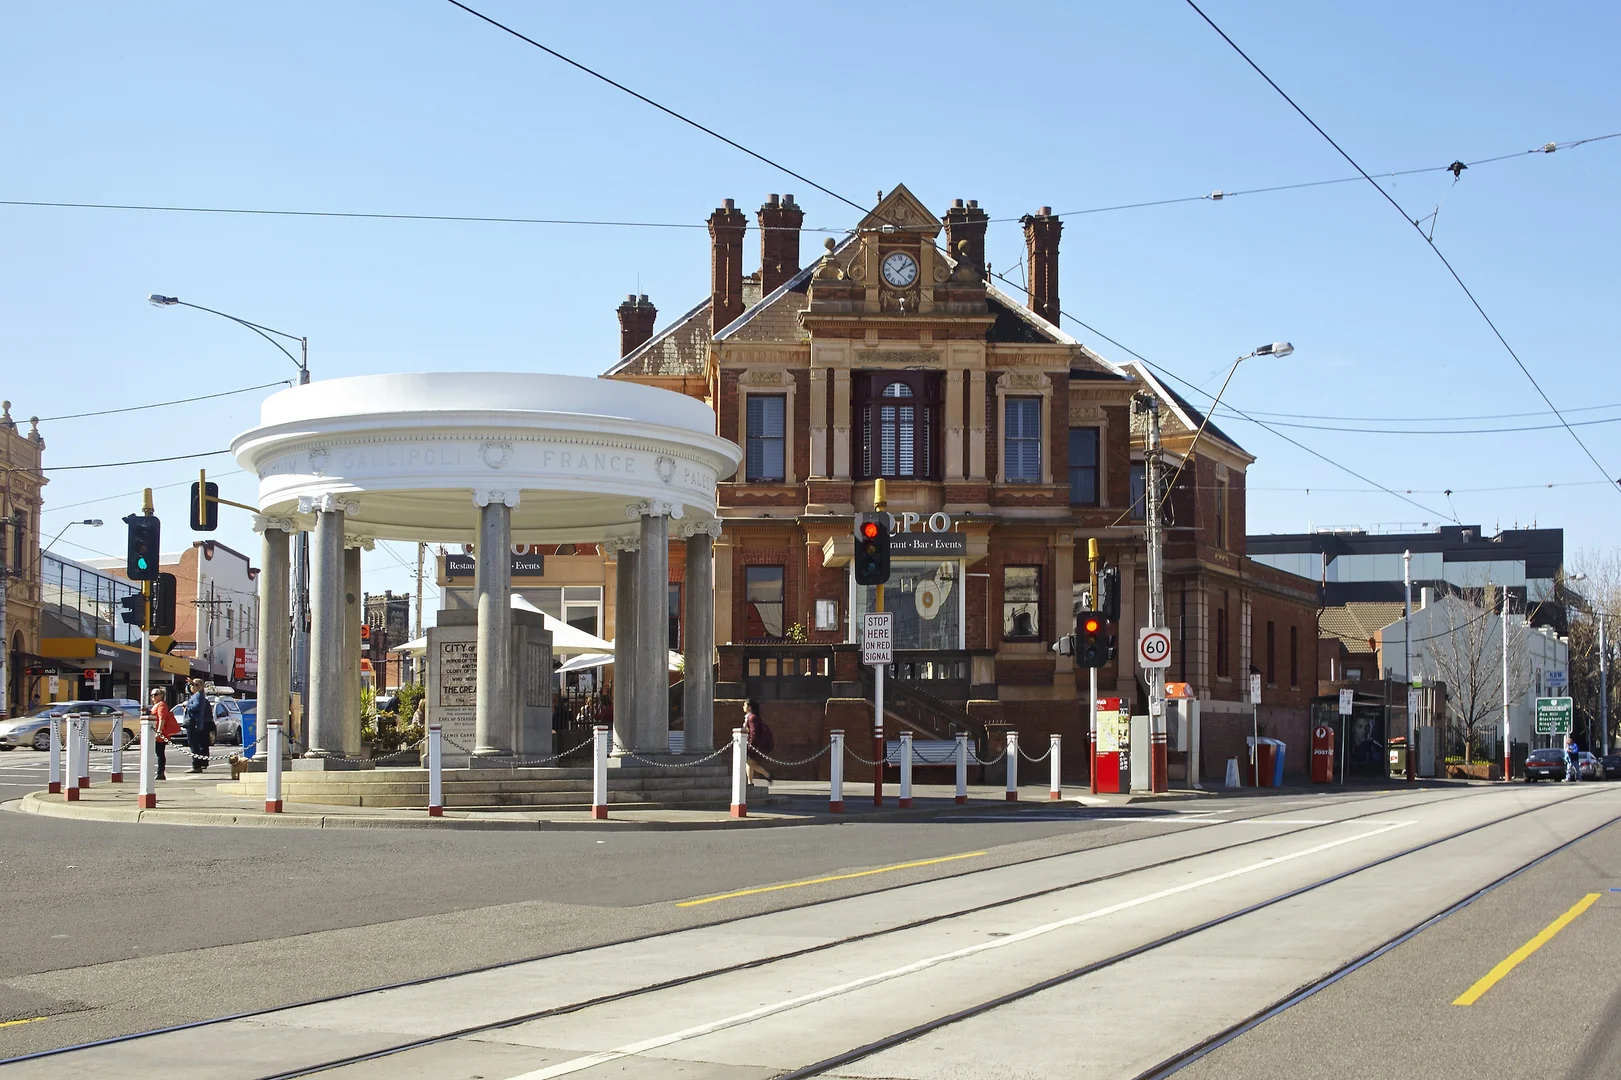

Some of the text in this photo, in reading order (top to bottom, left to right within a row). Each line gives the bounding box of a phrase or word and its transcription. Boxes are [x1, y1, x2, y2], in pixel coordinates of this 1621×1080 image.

[543, 451, 635, 473] FRANCE
[889, 539, 962, 549] rant Bar Events
[449, 561, 541, 570] Restau Events
[868, 616, 889, 627] STOP
[867, 629, 889, 639] HERE
[444, 644, 467, 652] CITY
[865, 641, 891, 650] ON RED
[1146, 640, 1165, 654] 60
[865, 652, 890, 661] SIGNAL
